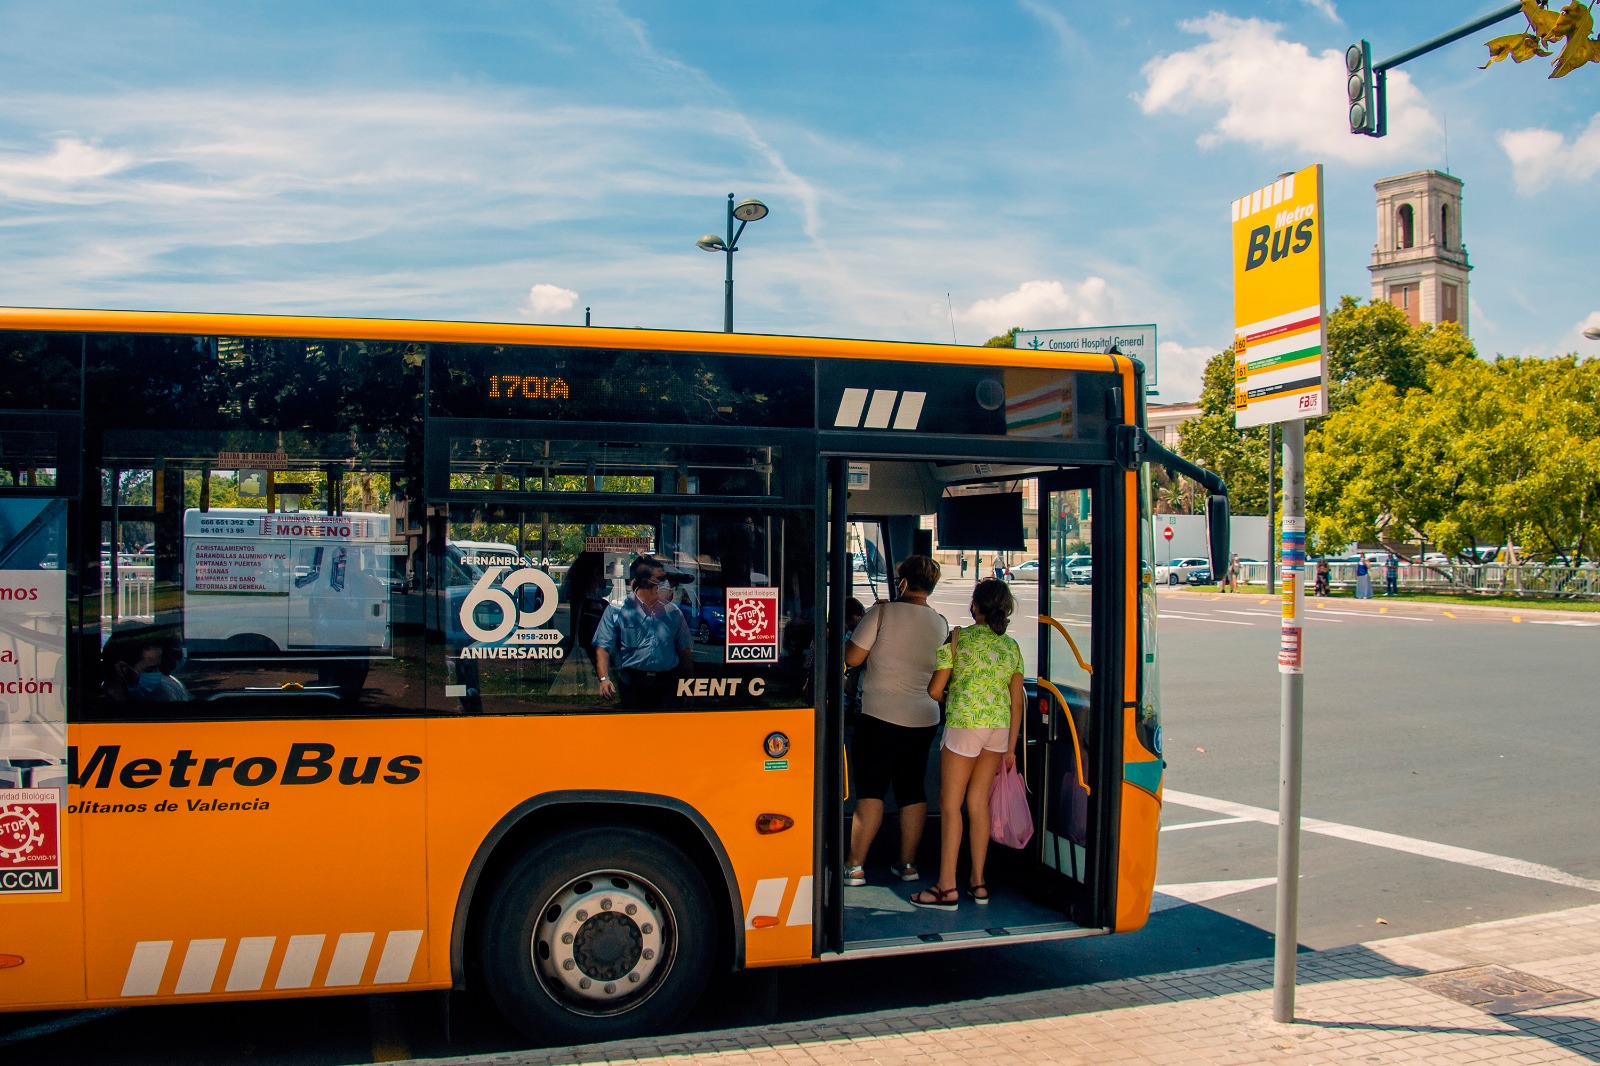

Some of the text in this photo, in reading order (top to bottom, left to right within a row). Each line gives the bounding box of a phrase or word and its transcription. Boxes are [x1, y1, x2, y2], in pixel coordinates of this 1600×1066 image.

[1274, 203, 1314, 230] Metro
[1245, 218, 1314, 272] Bus
[1049, 334, 1144, 350] Consorci Hospital General
[1235, 340, 1246, 349] 160
[1236, 367, 1246, 377] 161
[1236, 394, 1247, 405] 170
[276, 525, 351, 537] MORENO
[532, 557, 552, 566] S.A.
[460, 566, 559, 642] 60
[737, 609, 757, 621] STOP
[460, 647, 564, 659] ANIVERSARIO
[731, 646, 772, 659] ACCM
[676, 677, 766, 697] KENT C
[67, 742, 423, 789] MetroBus
[22, 792, 55, 801] Biológica
[154, 800, 178, 813] de
[187, 798, 269, 812] Valencia
[0, 820, 26, 835] STOP
[0, 871, 52, 888] CCM
